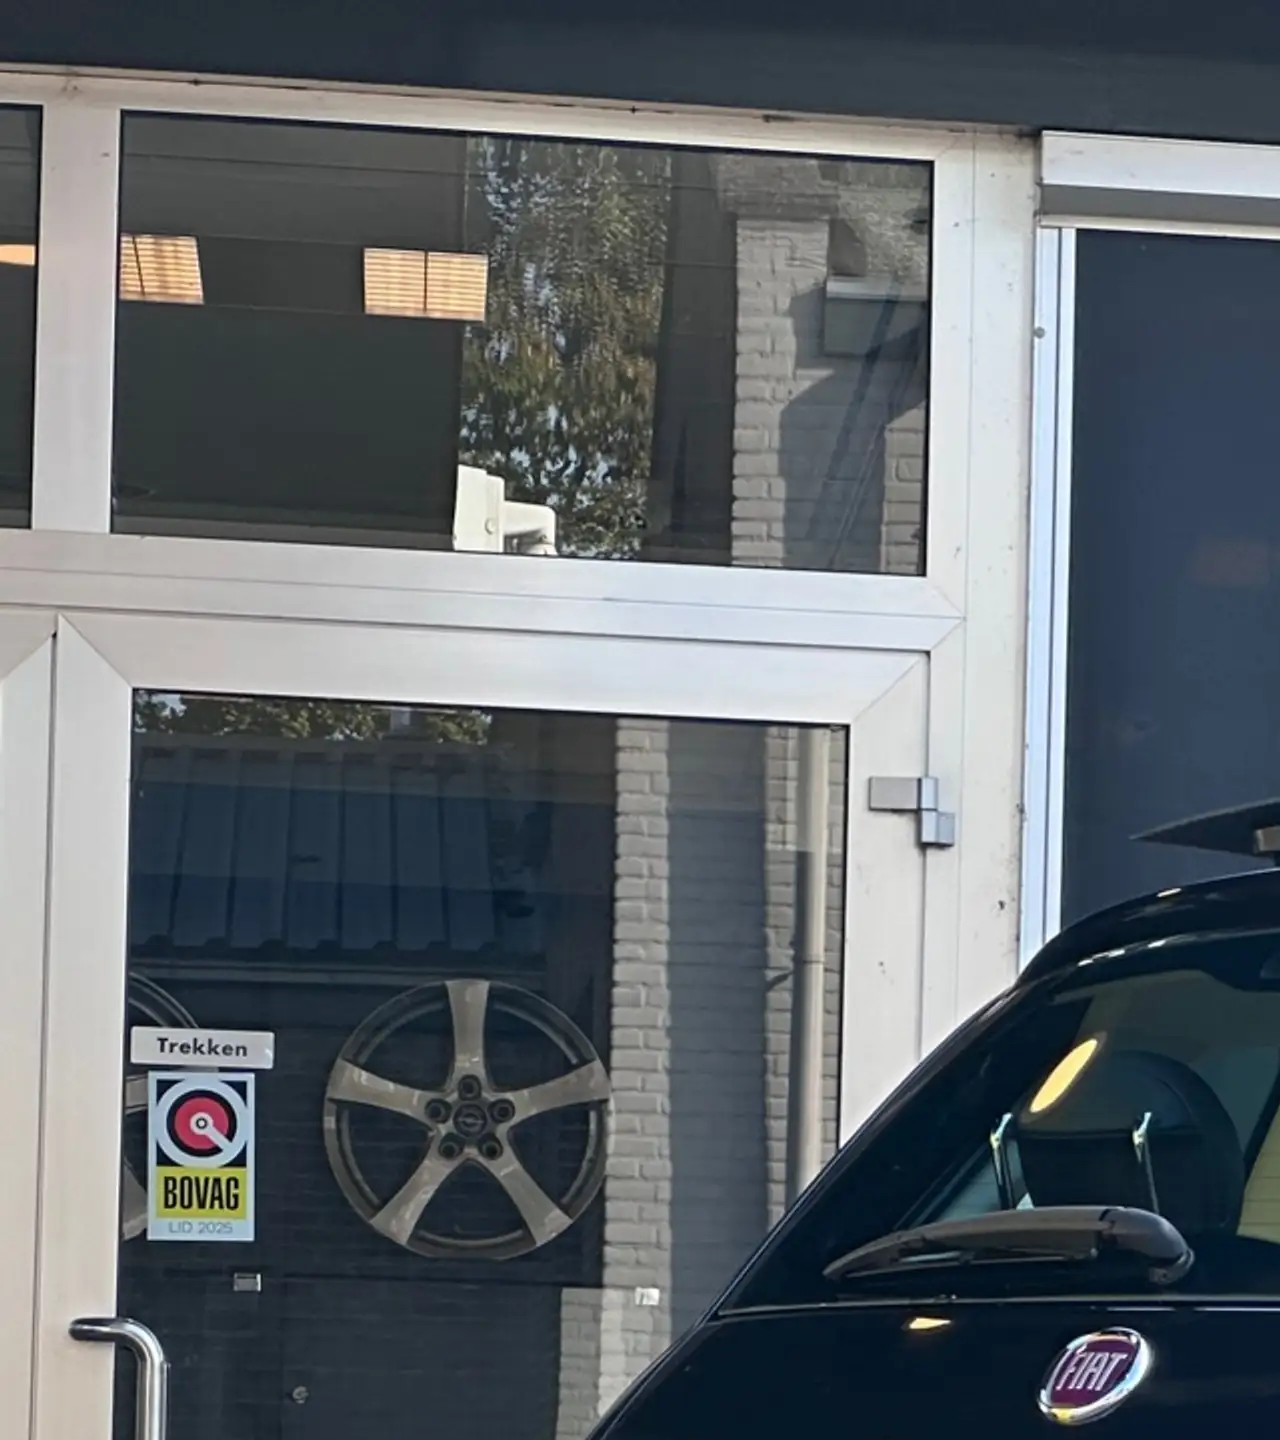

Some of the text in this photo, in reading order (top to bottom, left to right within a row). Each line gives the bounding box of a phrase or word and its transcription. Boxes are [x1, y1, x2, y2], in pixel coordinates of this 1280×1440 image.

[157, 1037, 248, 1057] Trekken
[163, 1176, 240, 1211] BOVAG
[168, 1221, 234, 1234] LID 2025
[1055, 1351, 1128, 1391] FIAT
